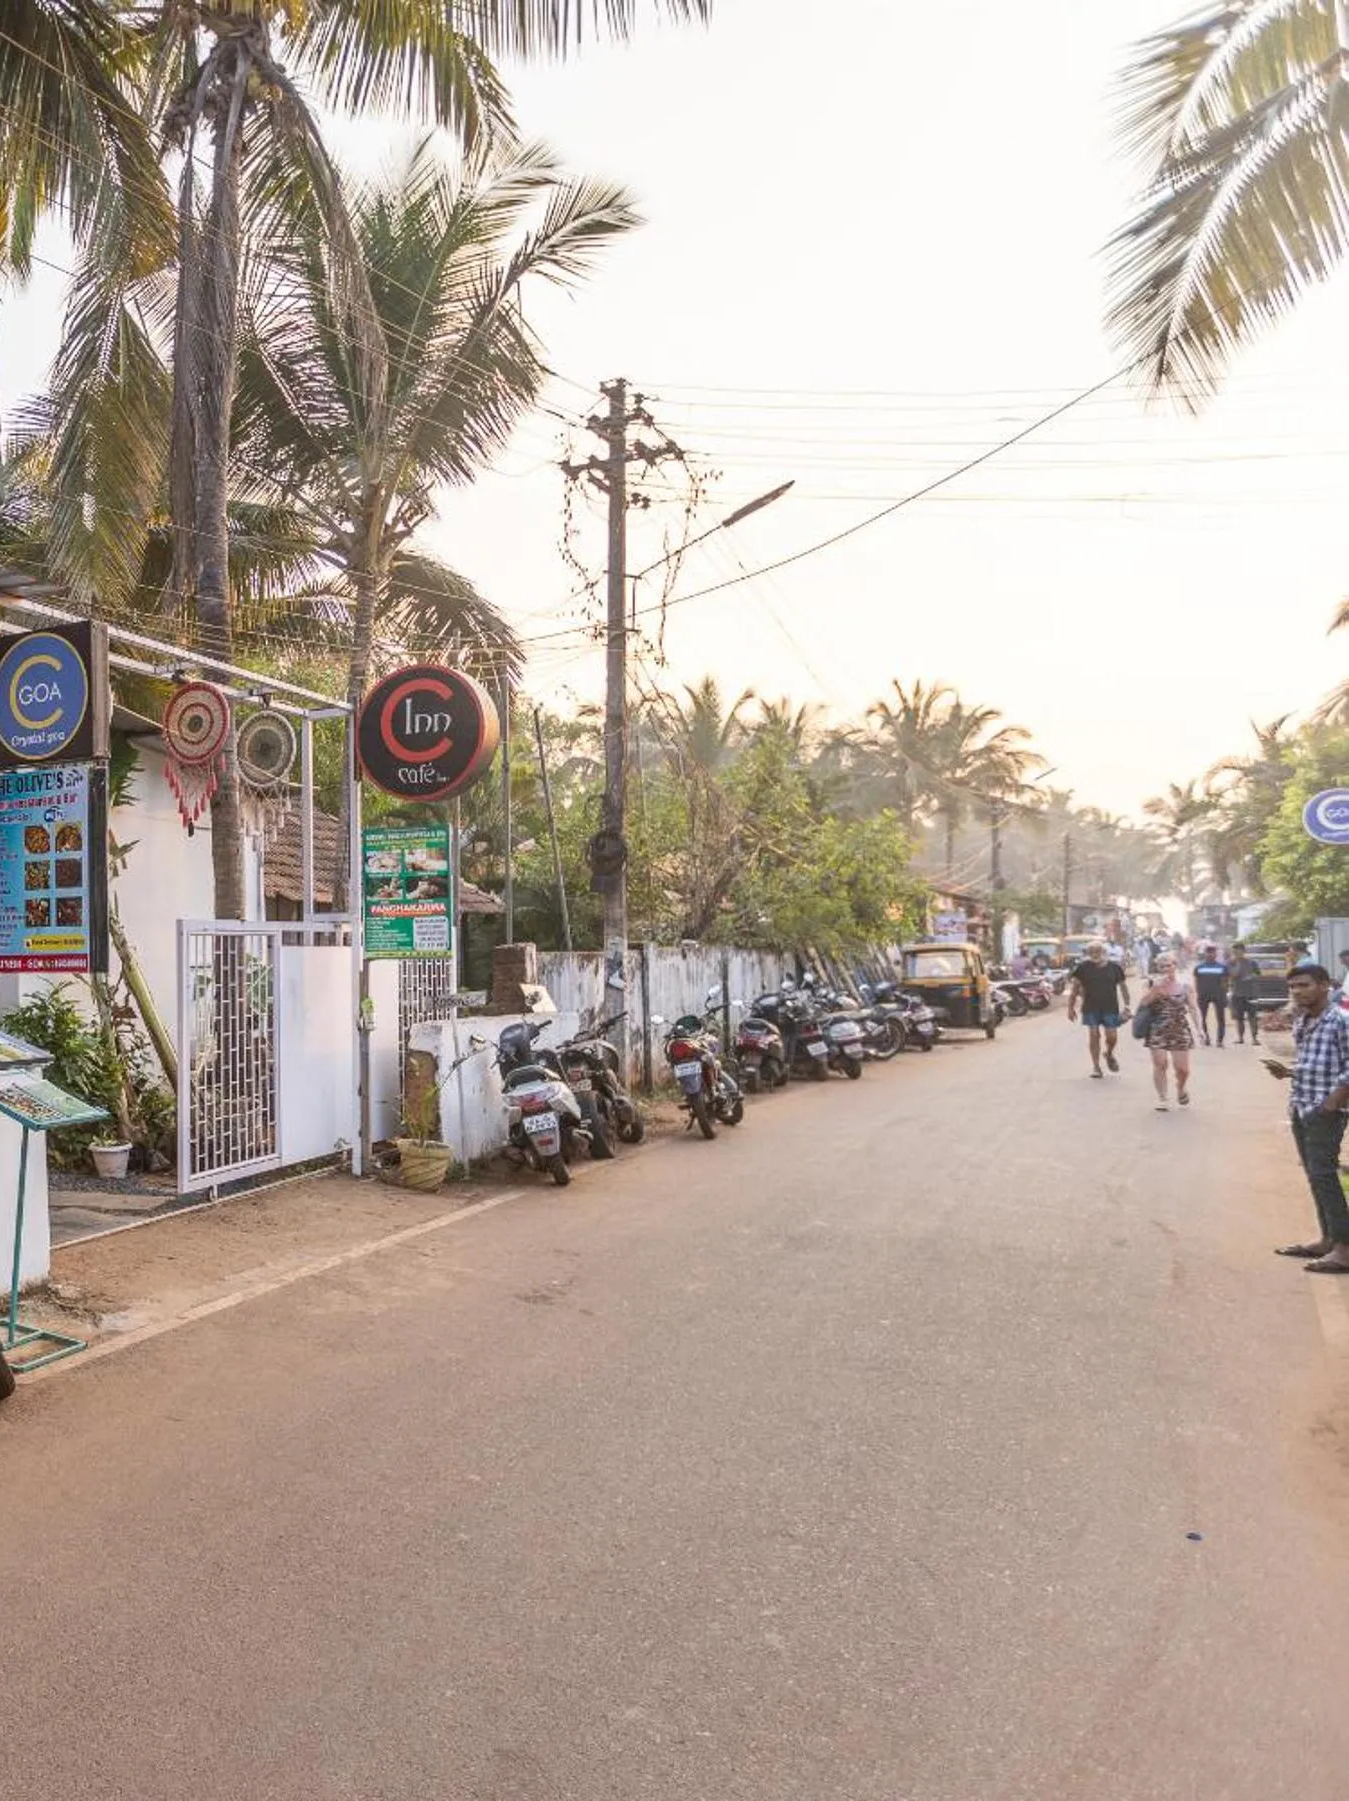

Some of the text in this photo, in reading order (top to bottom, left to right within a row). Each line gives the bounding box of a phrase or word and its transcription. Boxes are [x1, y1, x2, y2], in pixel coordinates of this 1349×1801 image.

[18, 681, 62, 705] GOA
[405, 698, 451, 735] Inn
[11, 731, 45, 747] Crystal
[17, 772, 64, 793] OLIVE'S
[398, 762, 435, 784] café
